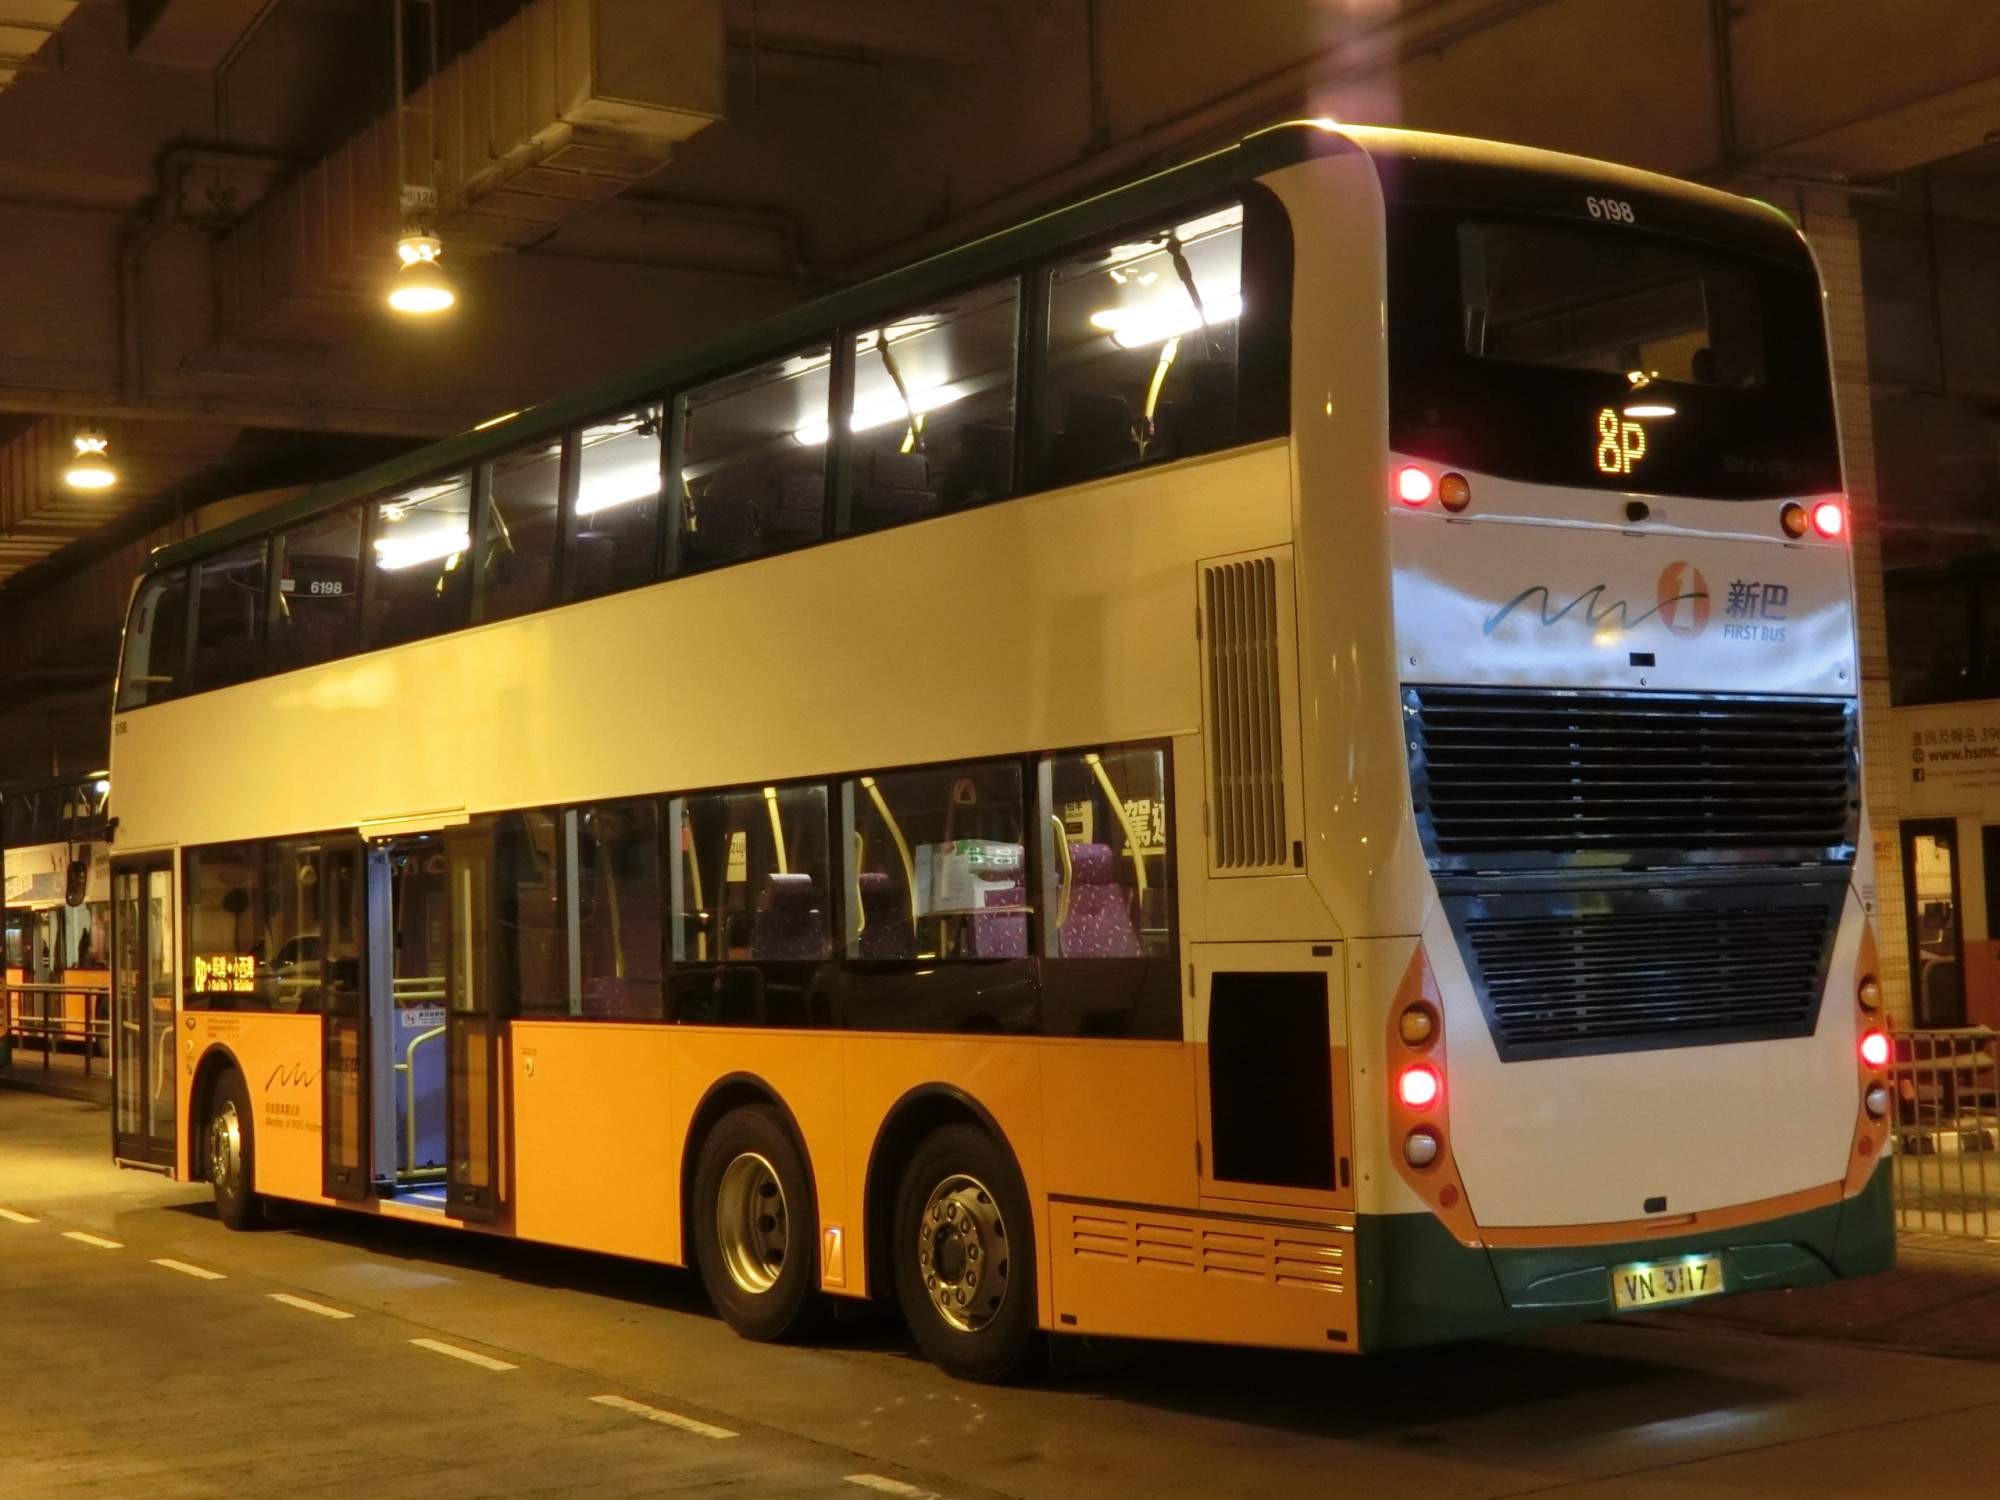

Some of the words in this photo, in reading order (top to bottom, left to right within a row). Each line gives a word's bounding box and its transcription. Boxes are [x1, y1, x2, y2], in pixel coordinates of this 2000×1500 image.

[1586, 196, 1635, 224] 6198
[1599, 408, 1645, 473] 8P
[310, 581, 342, 594] 6198
[1725, 579, 1788, 621] 新巴
[1723, 624, 1759, 641] FIRST
[1761, 626, 1786, 642] BUS
[195, 956, 207, 993] 8P
[1624, 1272, 1655, 1301] VN
[1663, 1263, 1708, 1294] 3117
